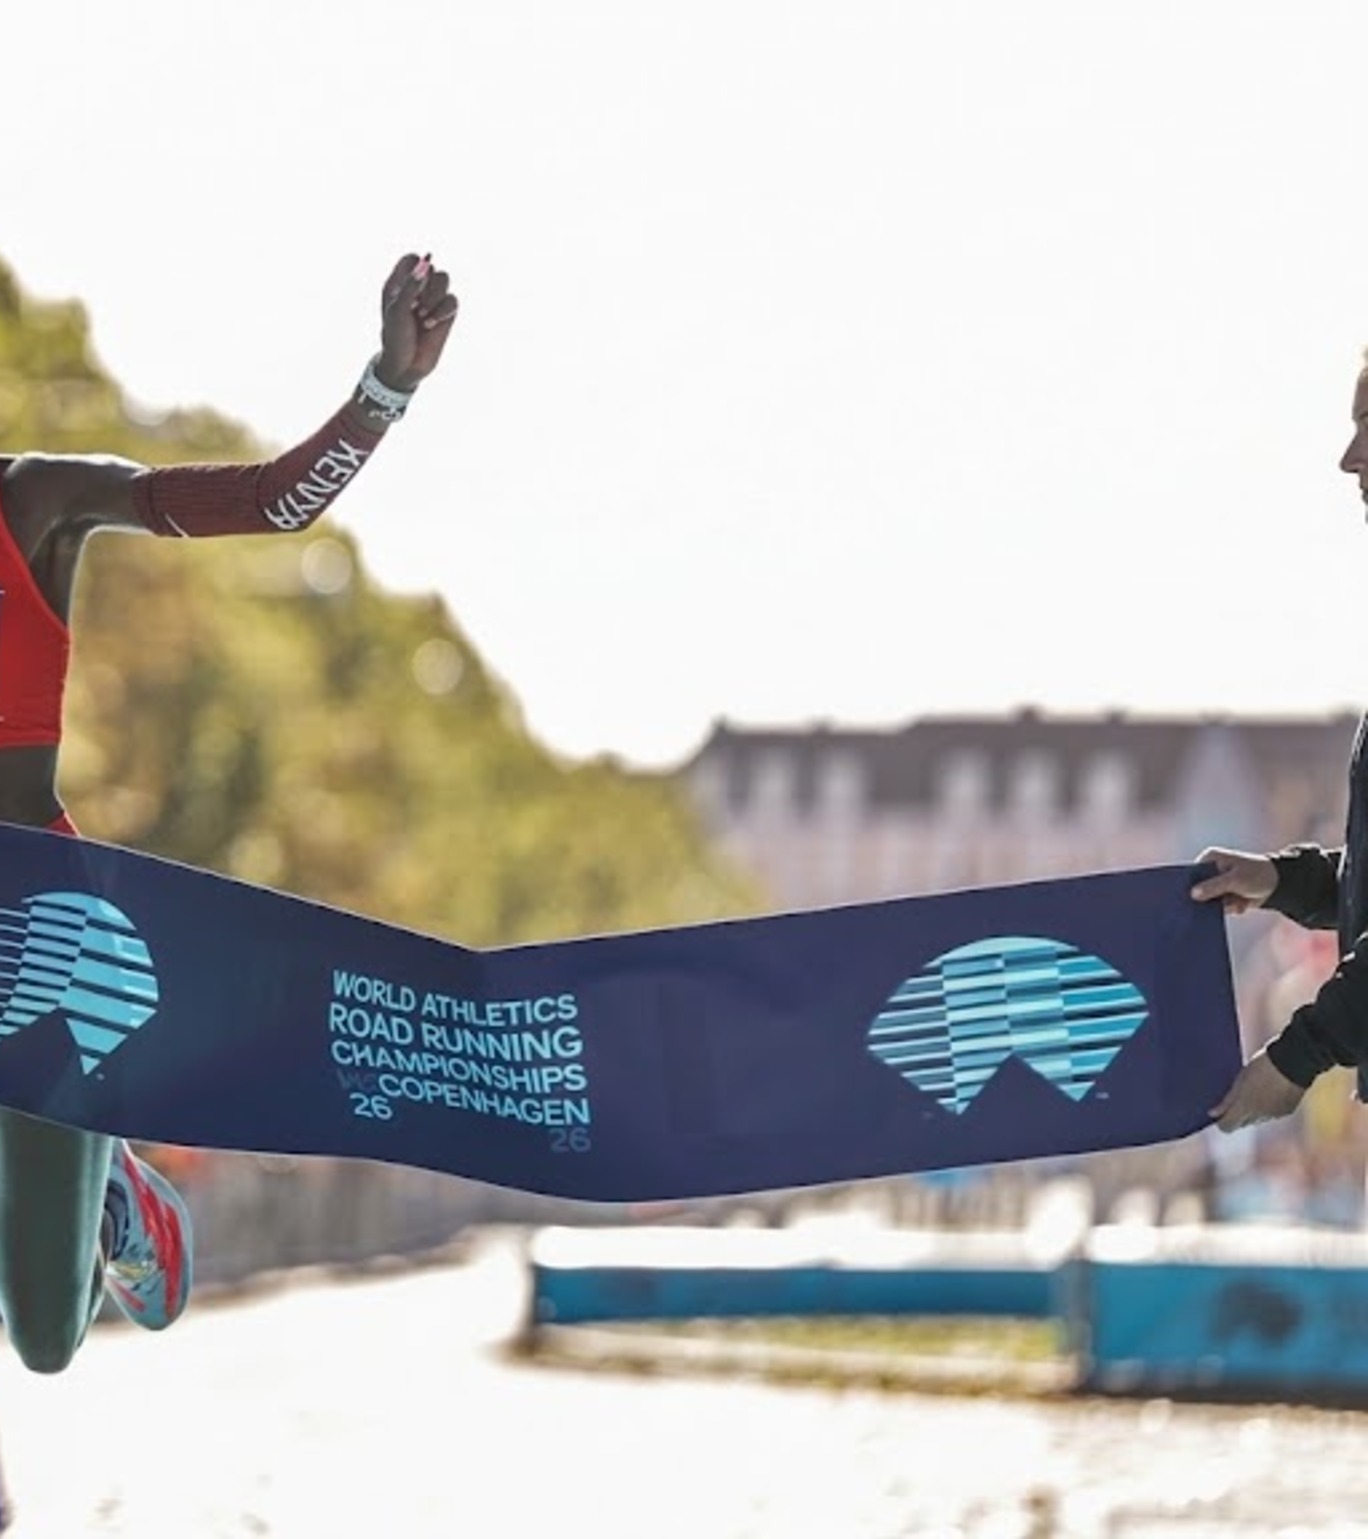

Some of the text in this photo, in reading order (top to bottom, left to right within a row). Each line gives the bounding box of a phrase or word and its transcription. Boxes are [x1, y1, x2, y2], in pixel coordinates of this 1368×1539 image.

[264, 438, 369, 530] KENYA
[333, 970, 578, 1027] WORLD ATHLETICS
[330, 1002, 582, 1060] ROAD RUNNING
[331, 1040, 587, 1094] CHAMPIONSHIPS
[349, 1092, 392, 1120] 26
[378, 1073, 590, 1125] COPENHAGEN
